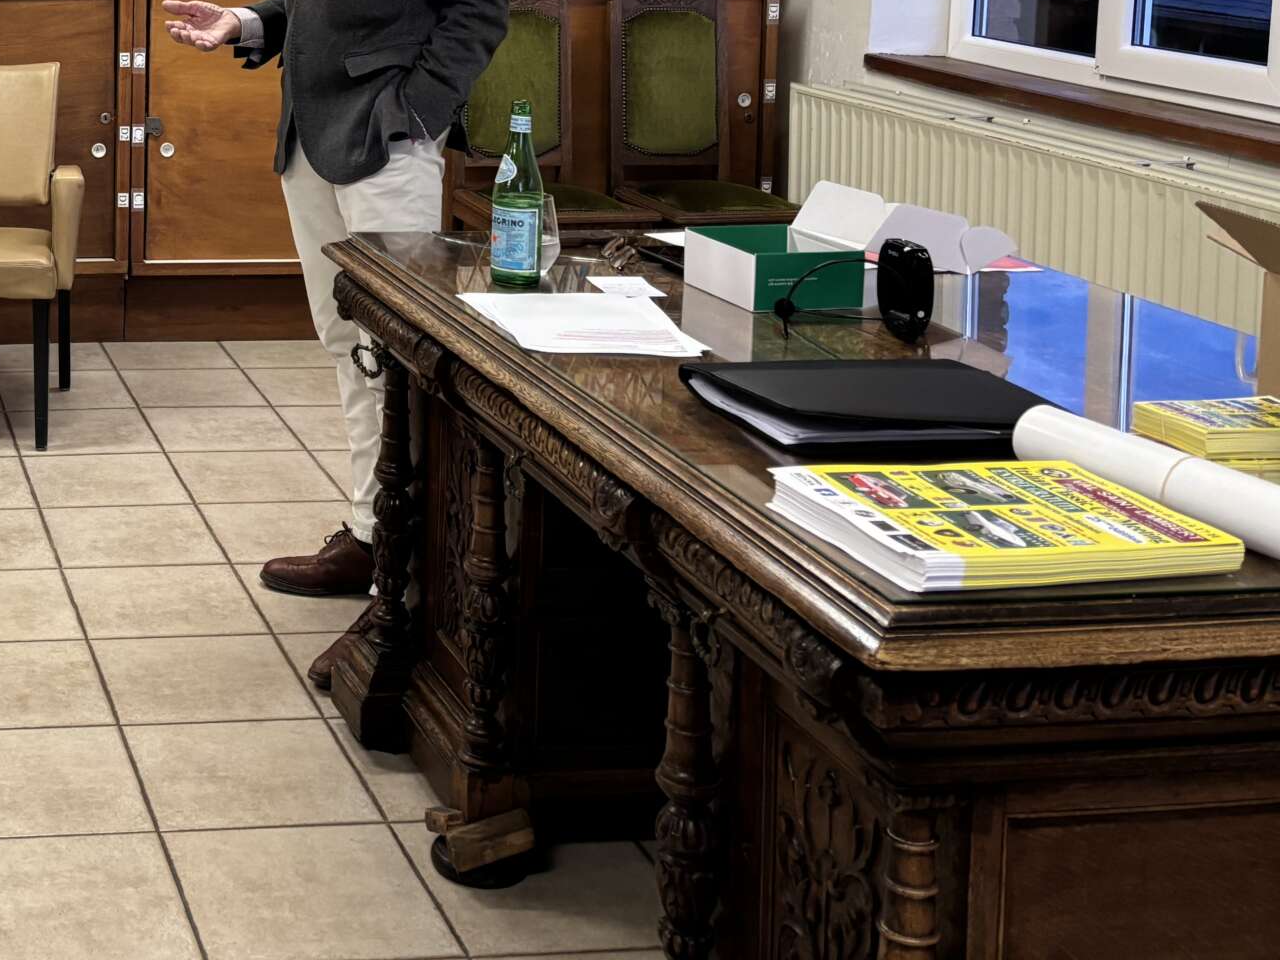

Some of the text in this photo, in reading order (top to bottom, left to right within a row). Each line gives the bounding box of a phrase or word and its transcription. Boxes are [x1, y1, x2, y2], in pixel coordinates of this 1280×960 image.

[120, 127, 129, 139] D2
[119, 195, 127, 206] D1
[493, 216, 525, 228] EGRINO
